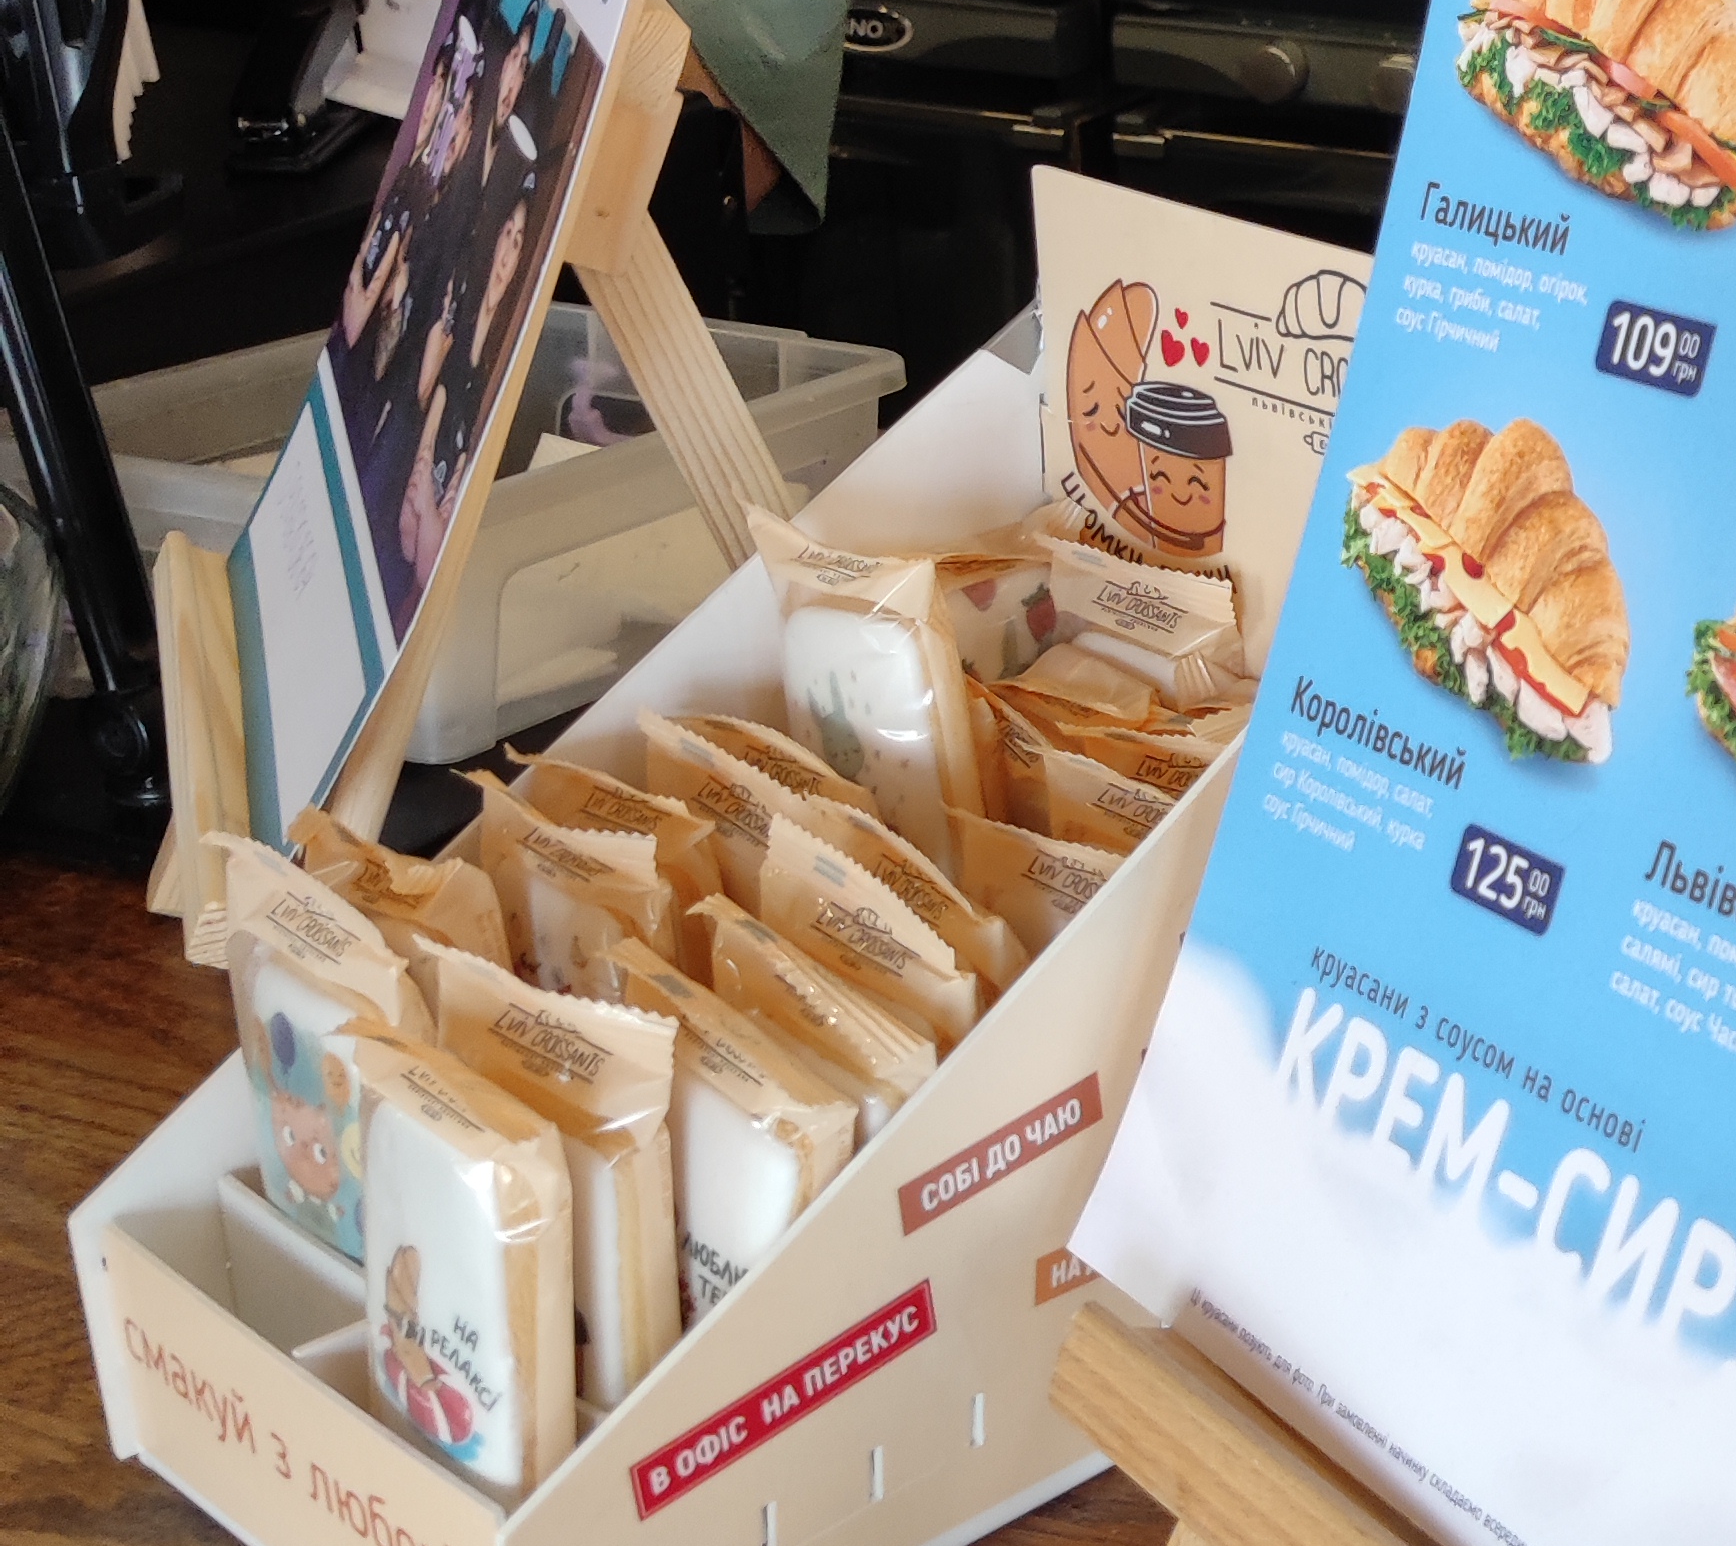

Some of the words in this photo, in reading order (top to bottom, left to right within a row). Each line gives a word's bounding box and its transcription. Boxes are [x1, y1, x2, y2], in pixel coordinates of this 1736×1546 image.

[1420, 180, 1572, 256] Галицький
[1403, 274, 1444, 302] курка,
[1448, 283, 1494, 319] гриби,
[1496, 301, 1542, 331] салат,
[1411, 240, 1470, 276] круасан,
[1473, 253, 1534, 293] помідор,
[1539, 274, 1589, 306] огірок,
[1395, 305, 1426, 333] соус
[1610, 310, 1678, 378] 109
[1678, 330, 1701, 358] 00
[1672, 357, 1697, 384] грн
[1281, 730, 1333, 770] круасан,
[1290, 675, 1468, 791] Королівський
[1263, 794, 1291, 820] соус
[1273, 761, 1296, 788] сир
[1386, 817, 1426, 851] курка
[1465, 836, 1529, 911] 125
[1528, 868, 1551, 899] 00
[1522, 895, 1547, 921] грн
[1632, 898, 1702, 950] круасан,
[1621, 934, 1683, 985] салямі,
[1687, 964, 1721, 1002] сир
[1609, 970, 1662, 1016] салат,
[1665, 997, 1702, 1034] соус
[1310, 945, 1411, 1021] круасани
[1415, 1004, 1428, 1031] з
[1435, 1016, 1516, 1081] соусом
[1522, 1065, 1553, 1103] на
[1561, 1087, 1647, 1154] основі
[920, 1157, 981, 1212] СОБІ
[983, 1132, 1023, 1179] ДО
[1024, 1097, 1084, 1147] ЧАЮ
[454, 1315, 479, 1352] НА
[648, 1464, 671, 1497] В
[674, 1415, 749, 1478] ОФІС
[760, 1384, 802, 1426] НА
[802, 1304, 922, 1399] ПЕРЕКУС
